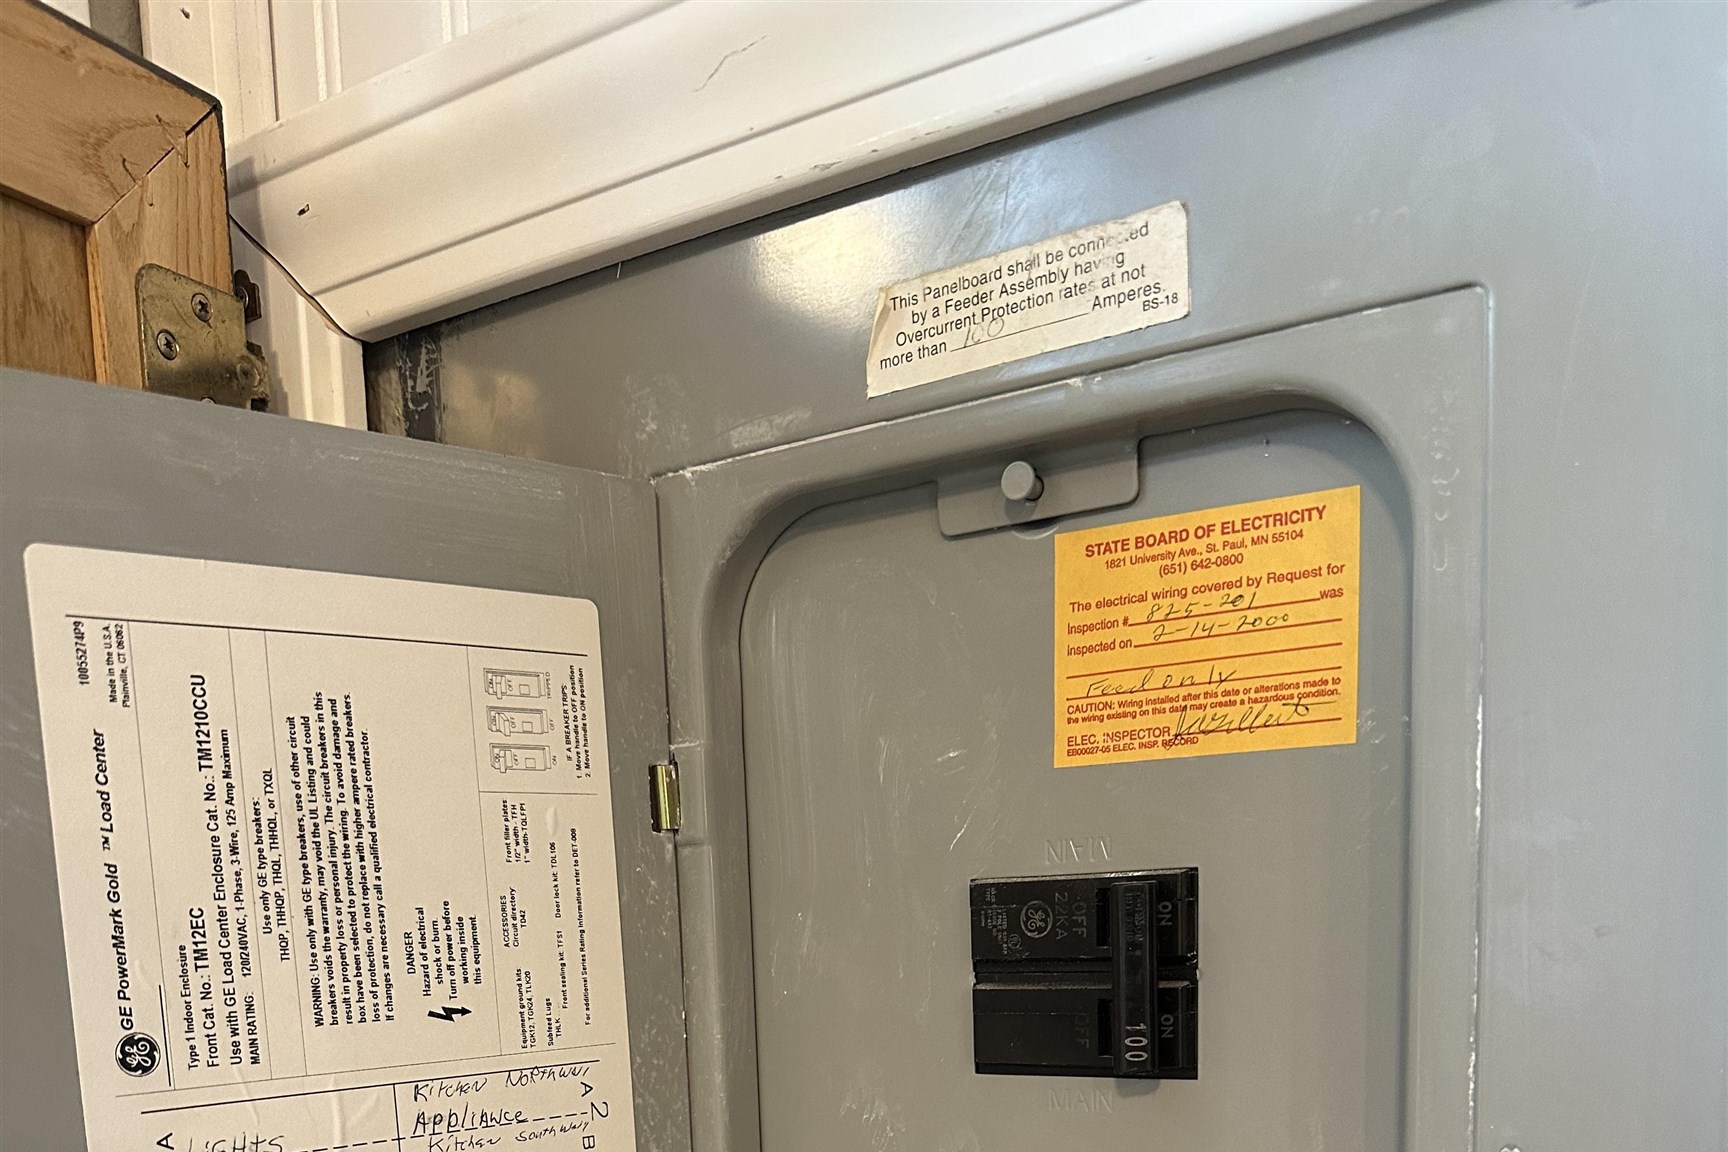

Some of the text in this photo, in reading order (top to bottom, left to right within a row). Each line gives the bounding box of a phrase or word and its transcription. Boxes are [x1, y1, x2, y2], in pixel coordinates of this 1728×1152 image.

[889, 221, 1149, 311] This Panelboard shall be conneced
[896, 264, 1145, 347] Overcurrent Protection rates at not
[911, 252, 1125, 326] by a Feeder Assembly havng
[1142, 292, 1178, 312] BS-18
[880, 351, 913, 370] more
[917, 342, 947, 359] than
[1092, 282, 1165, 311] Amperes.
[1085, 505, 1326, 558] STATE BOARD OF ELECTRICITY
[1105, 528, 1304, 570] 1821 University Ave., St. Paul, MN 55104
[1159, 553, 1244, 578] (651) 642-0800
[1069, 563, 1345, 613] The electrical wiring covered by Request for
[1067, 618, 1119, 636] Inspection
[1122, 616, 1129, 627] #
[1319, 587, 1344, 601] was
[73, 621, 90, 685] 10055274P9
[102, 621, 117, 703] Made in the U.S.A.
[114, 623, 130, 708] Plainville, CT 06062
[1067, 638, 1116, 657] Inspected
[1119, 638, 1133, 649] on
[1067, 677, 1341, 715] CAUTION: Wiring installed after this date or alterations made to
[1067, 688, 1341, 725] the wiring existing on this date may create a hazardous condition.
[92, 728, 108, 786] Center
[1067, 726, 1171, 747] ELEC. INSPECTOR
[1067, 736, 1199, 757] EB00027-05 ELEC. INSP. RECORD
[96, 790, 113, 833] Load
[104, 863, 120, 903] Gold
[190, 675, 242, 1065] Use with GE Load Center Enclosure Cat. No.: TM1210CCU
[220, 729, 260, 1065] MAIN RATING: 120/240VAC, 1-Phase, 3-Wire, 125 Amp Maximum
[1054, 892, 1068, 940] 22KA
[1157, 901, 1172, 925] ON
[1072, 903, 1088, 938] OFF
[109, 908, 131, 1001] PowerMark
[177, 945, 191, 998] Enclosure
[403, 931, 416, 974] DANGER
[189, 907, 220, 1067] Front Cat. No.: TM12EC
[119, 1006, 134, 1030] GE
[183, 1000, 195, 1034] Indoor
[1160, 1015, 1174, 1039] ON
[188, 1044, 200, 1071] Type
[1124, 1022, 1149, 1062] 100
